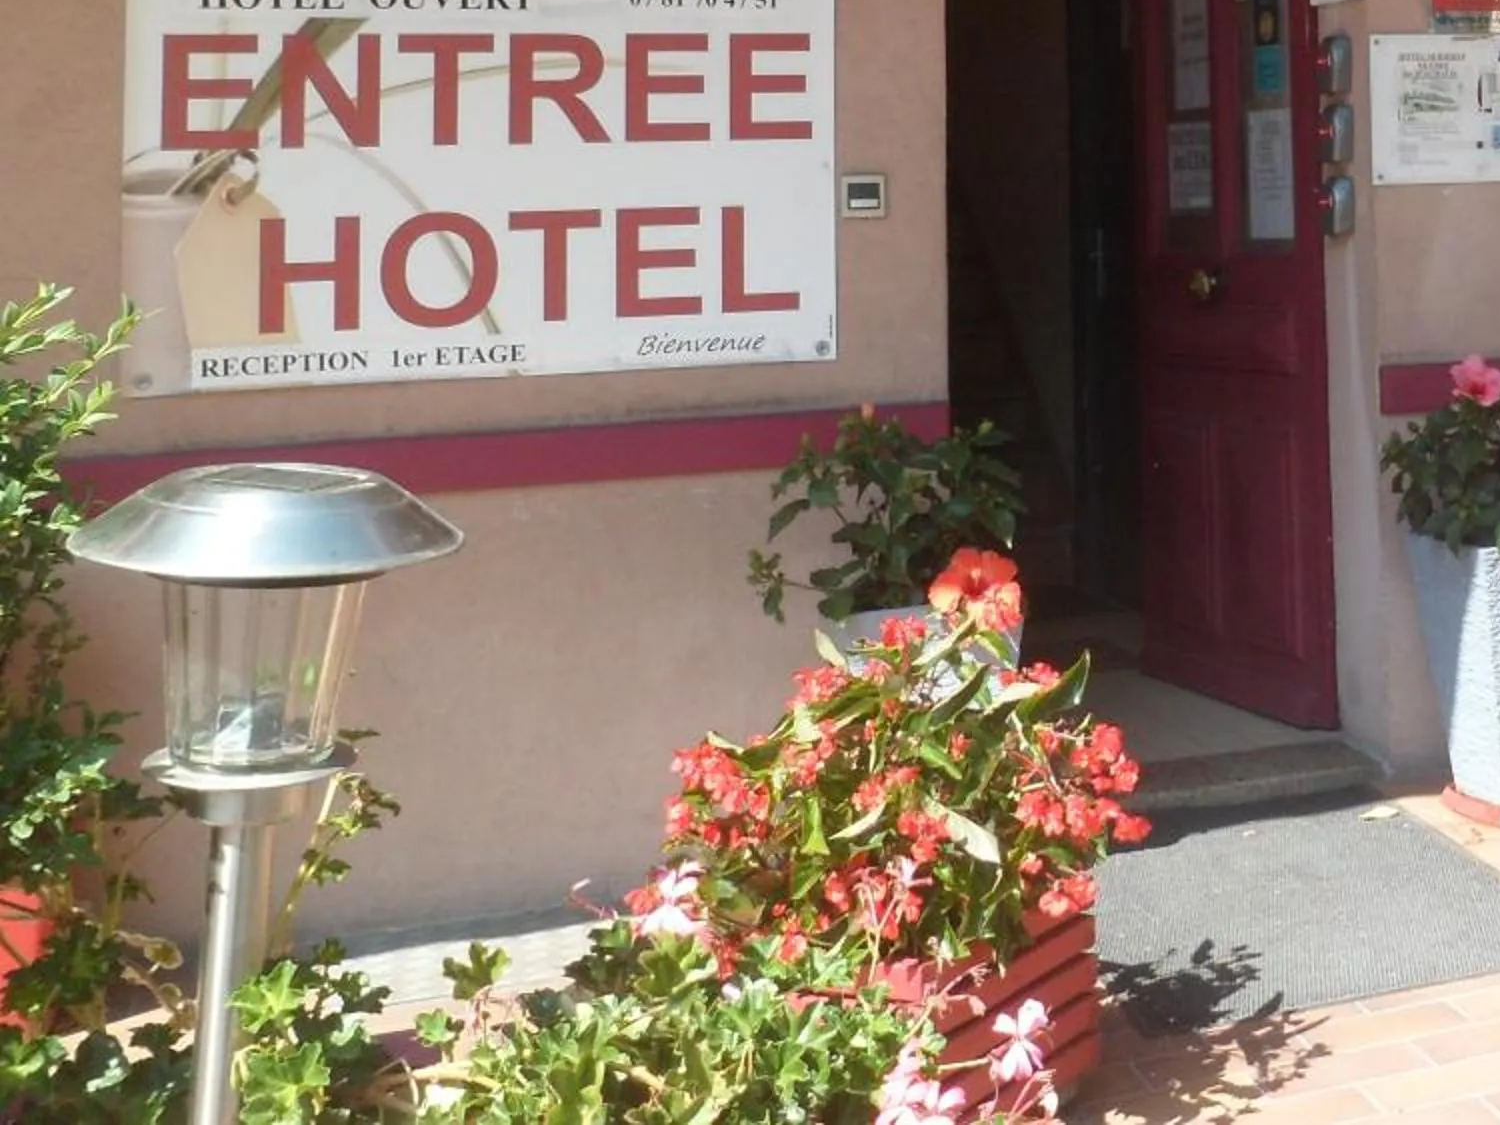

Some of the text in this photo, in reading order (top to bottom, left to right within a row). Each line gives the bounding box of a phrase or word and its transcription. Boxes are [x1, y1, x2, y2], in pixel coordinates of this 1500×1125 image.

[160, 31, 814, 153] ENTREE
[257, 205, 800, 335] HOTEL
[200, 343, 527, 379] RECEPTION 1er ETAGE
[636, 332, 766, 358] Bienvenue
